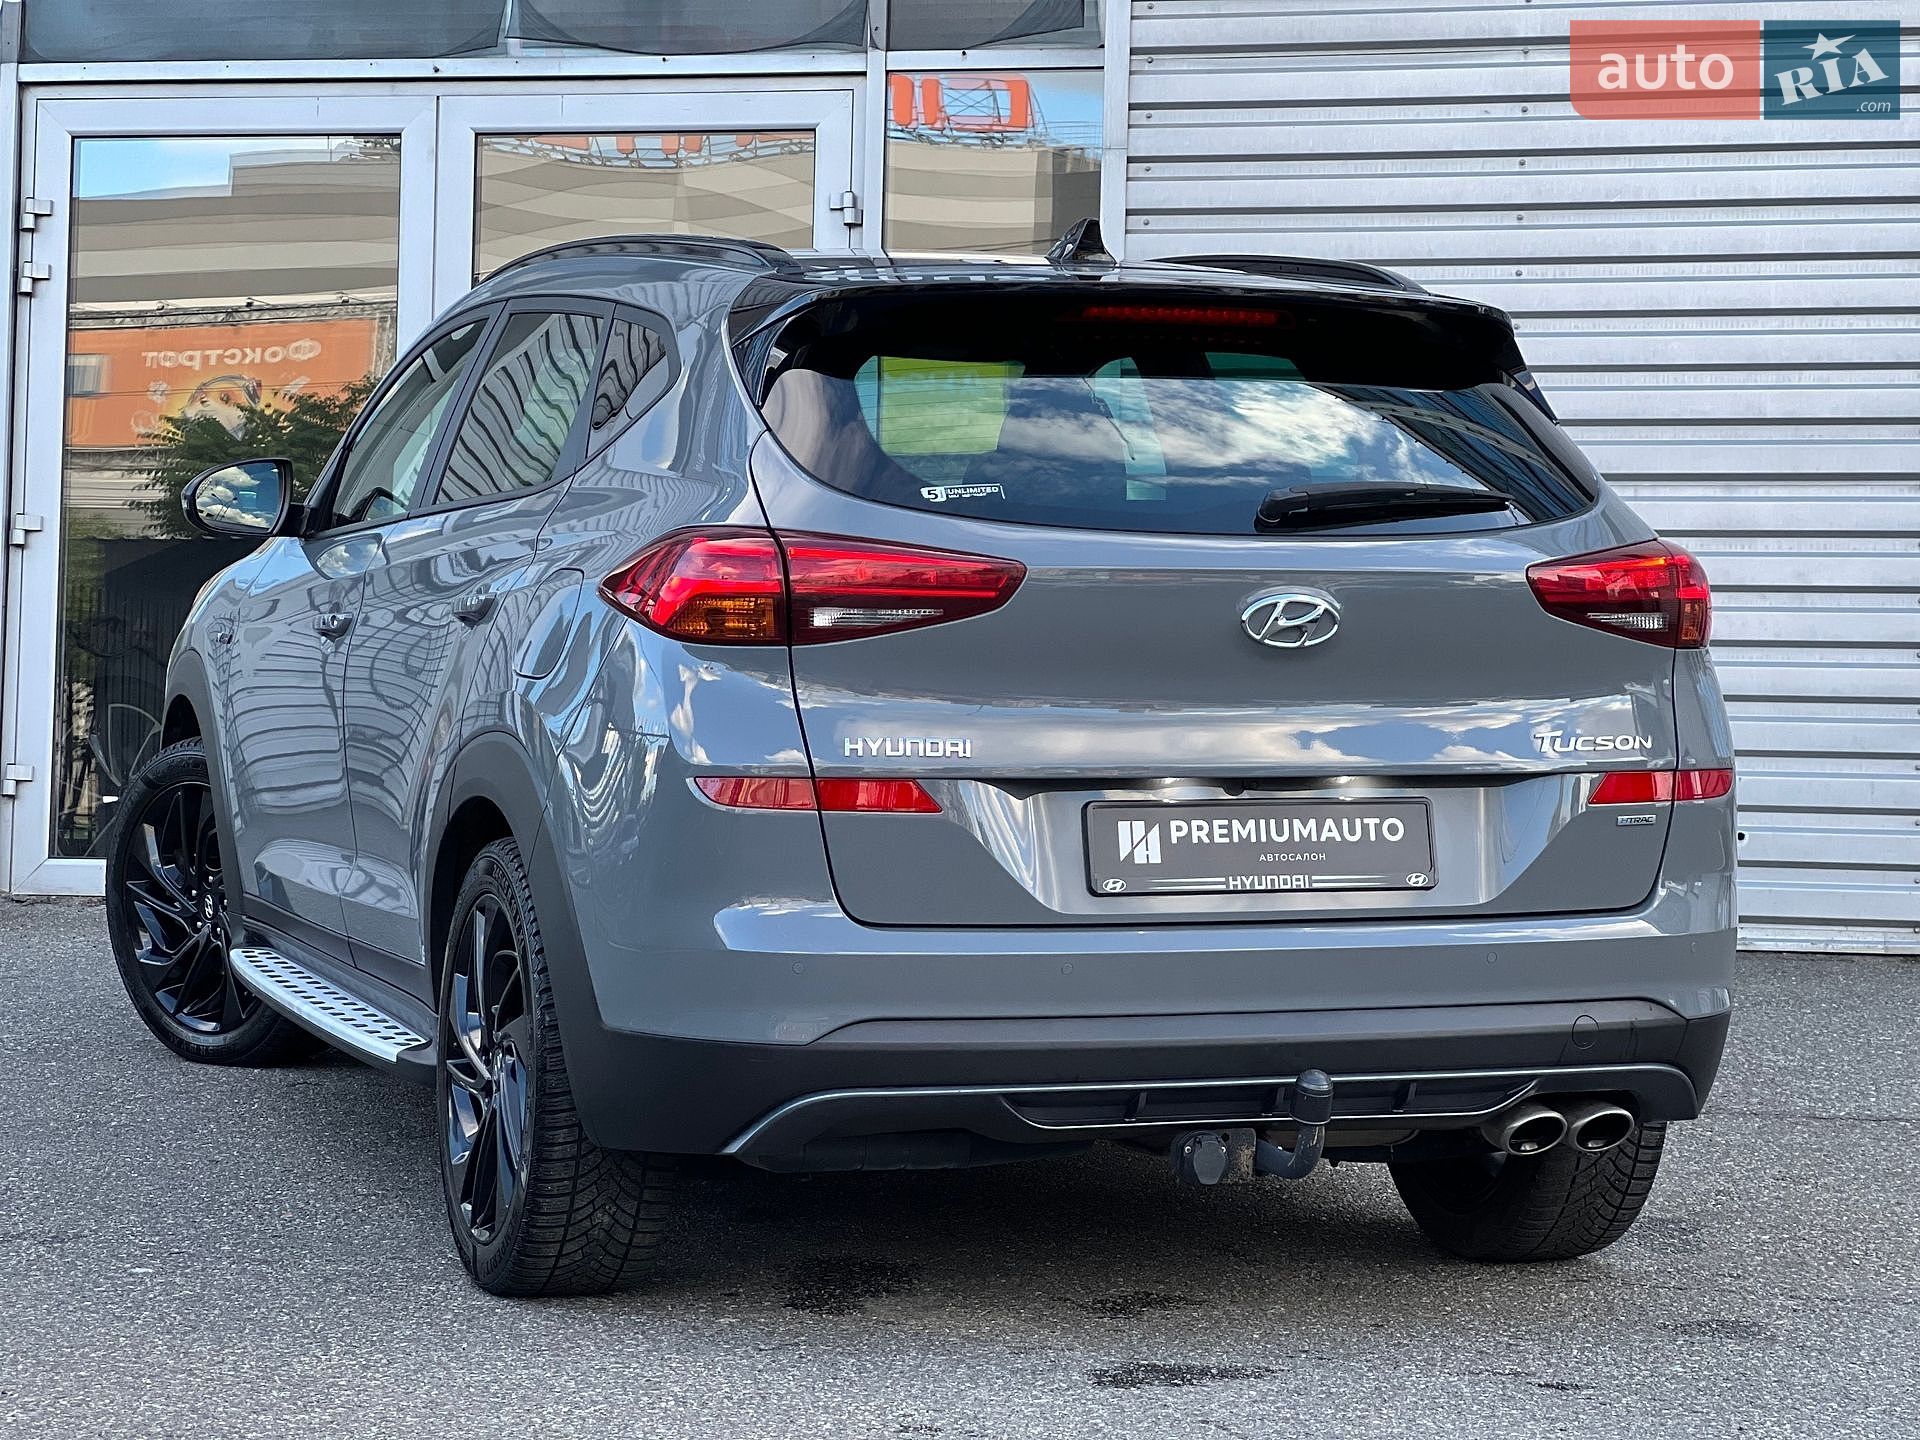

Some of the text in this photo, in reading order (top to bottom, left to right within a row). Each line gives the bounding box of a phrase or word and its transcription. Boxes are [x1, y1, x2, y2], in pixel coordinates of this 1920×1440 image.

[947, 486, 999, 495] UNLIMITED
[844, 737, 972, 758] HYUNDAI
[1534, 730, 1653, 752] TUCSON
[1169, 817, 1405, 844] PREMIUMAUTO
[1259, 852, 1326, 863] АВТОСАЛОН
[1228, 874, 1310, 890] HYUNDAI
